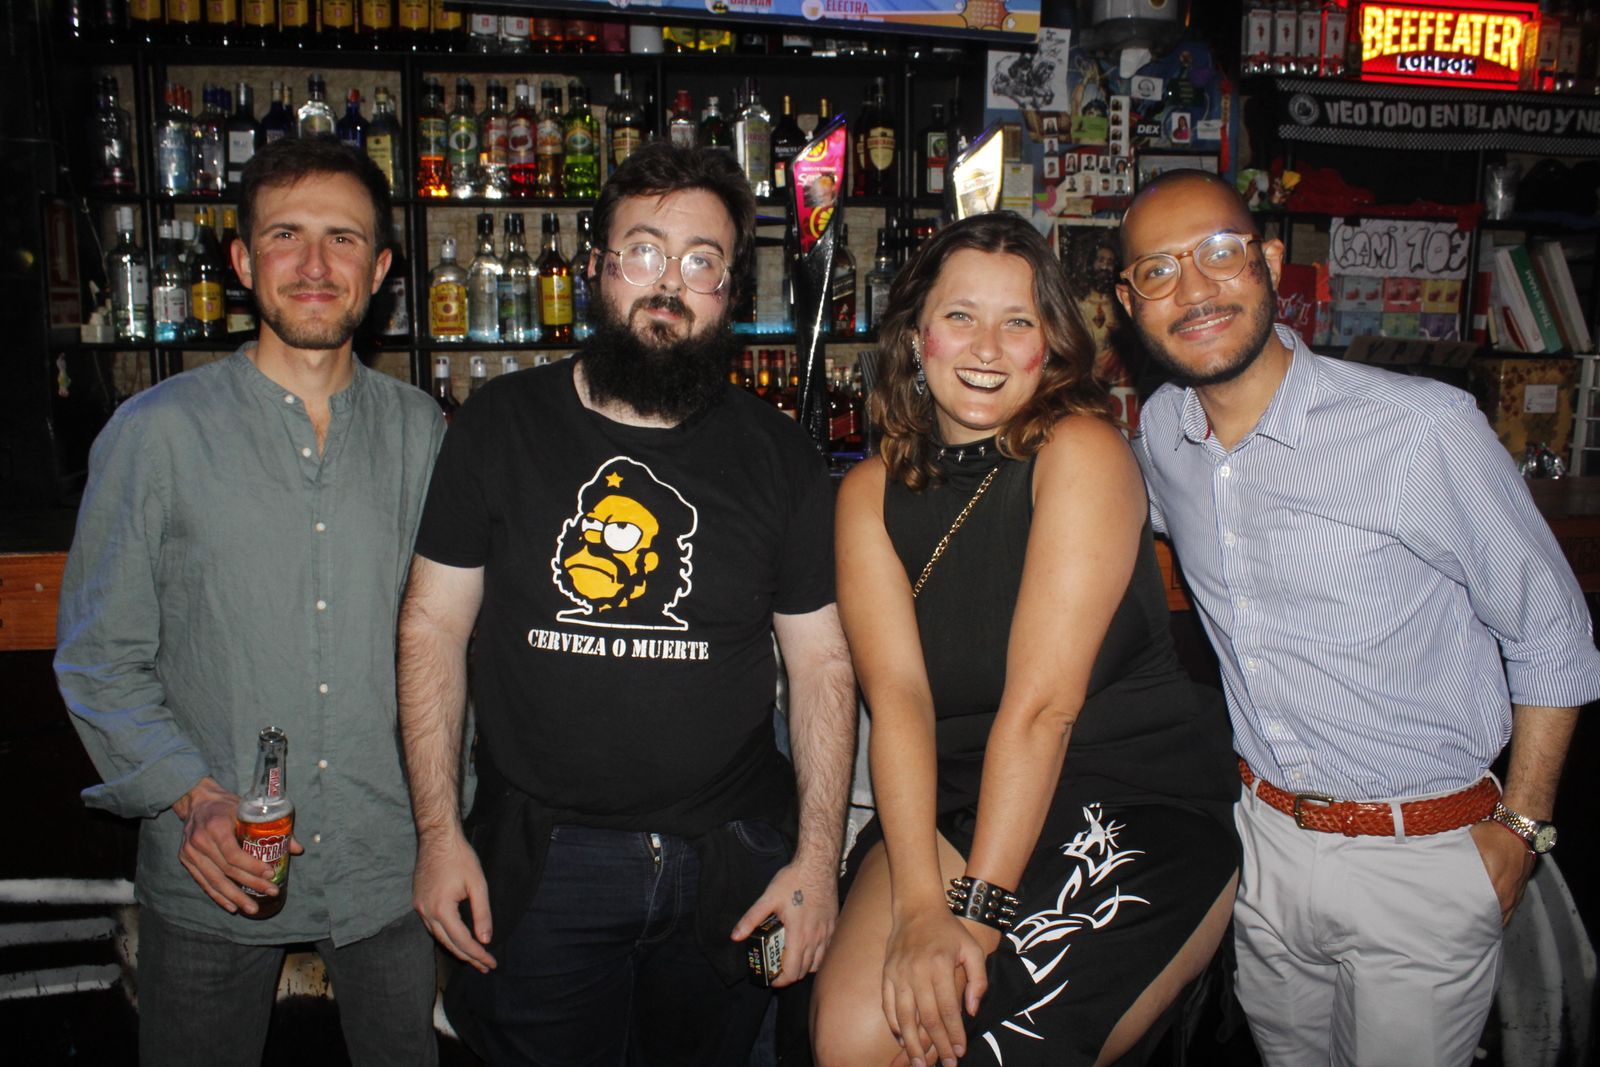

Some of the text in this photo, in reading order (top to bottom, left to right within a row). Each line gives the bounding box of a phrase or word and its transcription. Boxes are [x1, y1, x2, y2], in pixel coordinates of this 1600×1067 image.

[1362, 5, 1522, 71] BEEFEATER
[1397, 55, 1477, 75] LONDON
[1137, 124, 1160, 135] DEX
[1325, 100, 1367, 125] VEO
[1370, 101, 1426, 128] TODO
[1430, 104, 1459, 127] EN
[1463, 103, 1550, 132] BLANCO
[1554, 109, 1576, 134] Y
[527, 629, 709, 660] CERVEZA O MUERTE
